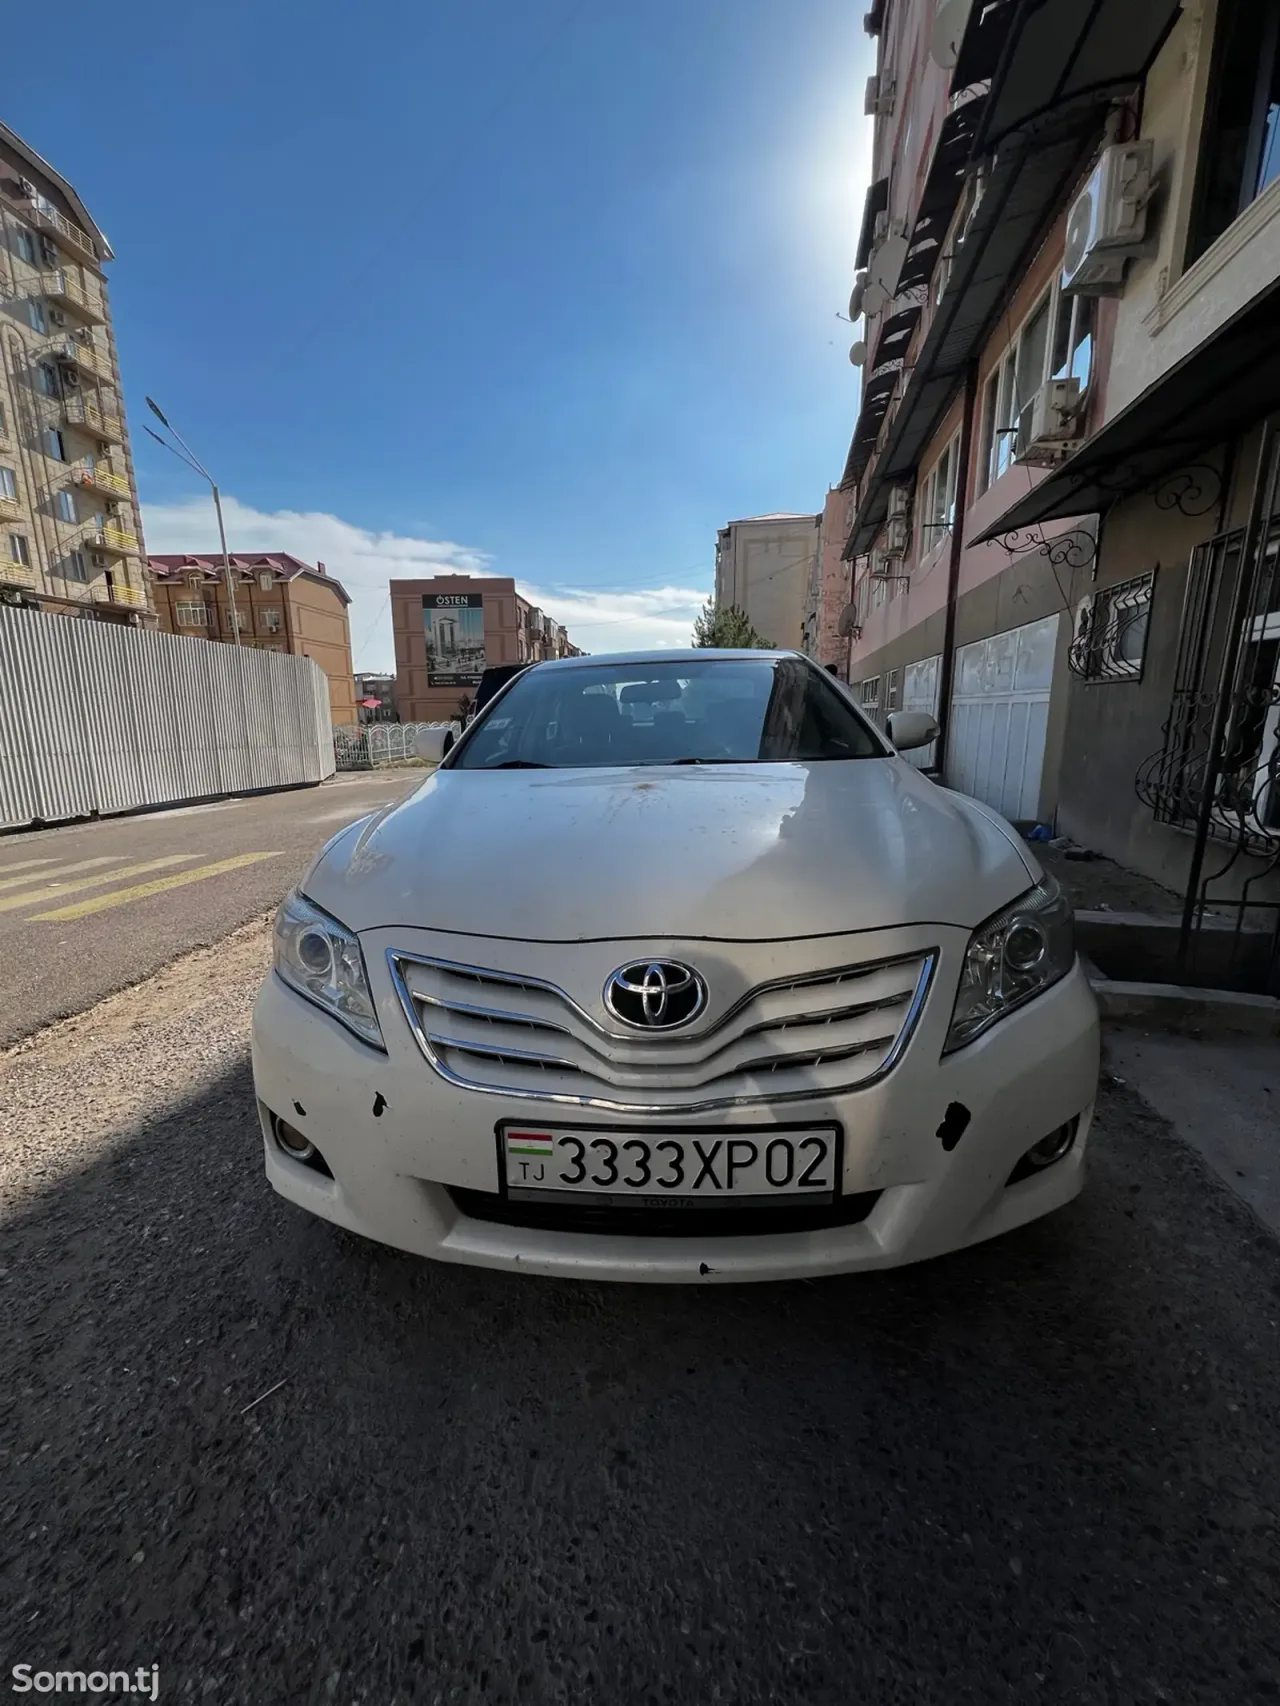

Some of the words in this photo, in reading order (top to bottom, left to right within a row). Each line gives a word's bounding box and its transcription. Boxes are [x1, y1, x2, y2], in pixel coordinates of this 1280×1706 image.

[518, 1161, 545, 1182] TJ
[557, 1136, 828, 1190] 3333XP02
[643, 1198, 695, 1207] TOYOTA
